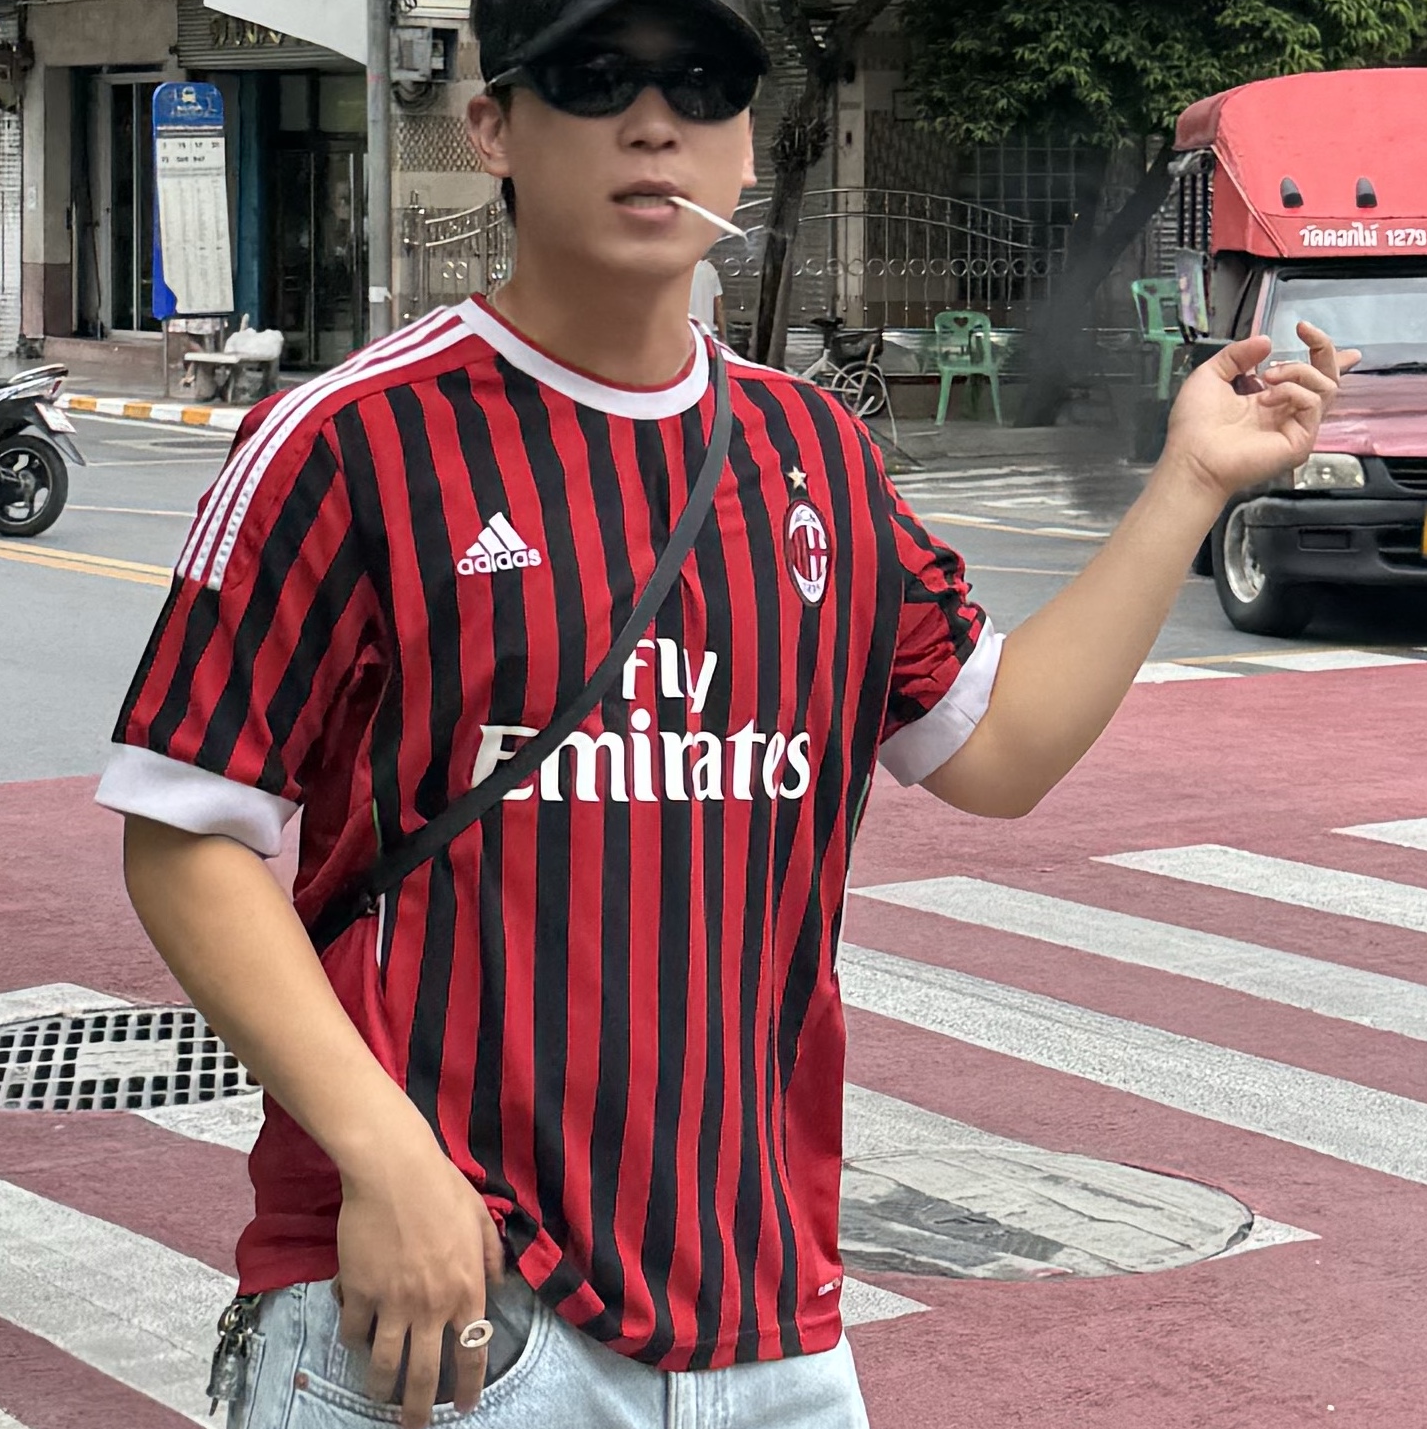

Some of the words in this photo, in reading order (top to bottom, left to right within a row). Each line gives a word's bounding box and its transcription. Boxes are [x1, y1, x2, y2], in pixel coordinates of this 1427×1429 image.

[1299, 222, 1379, 247] วัดดอกไม้
[1386, 228, 1427, 247] 1279
[457, 548, 542, 575] adidas
[622, 638, 717, 713] Fly
[472, 719, 811, 802] Emirates
